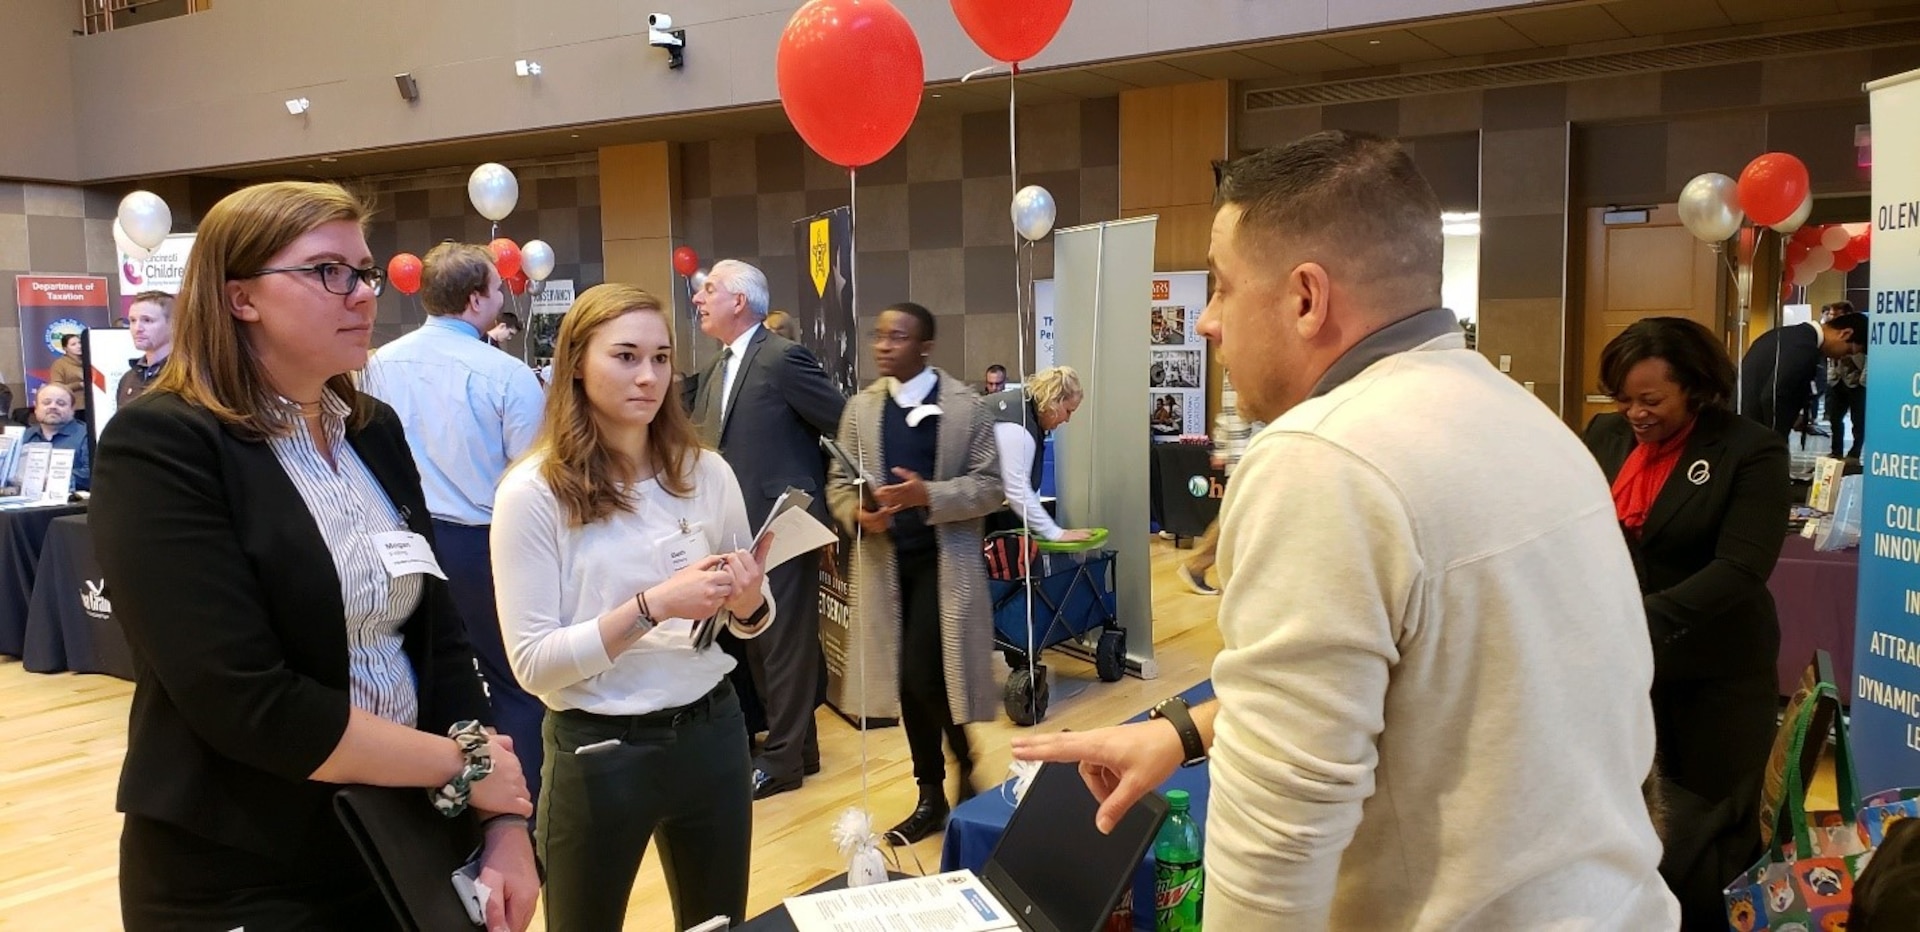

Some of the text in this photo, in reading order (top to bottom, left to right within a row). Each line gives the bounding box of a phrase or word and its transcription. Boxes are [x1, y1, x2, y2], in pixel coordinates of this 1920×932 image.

[32, 282, 94, 292] Department of
[46, 291, 84, 300] Taxation
[1870, 321, 1885, 345] AT
